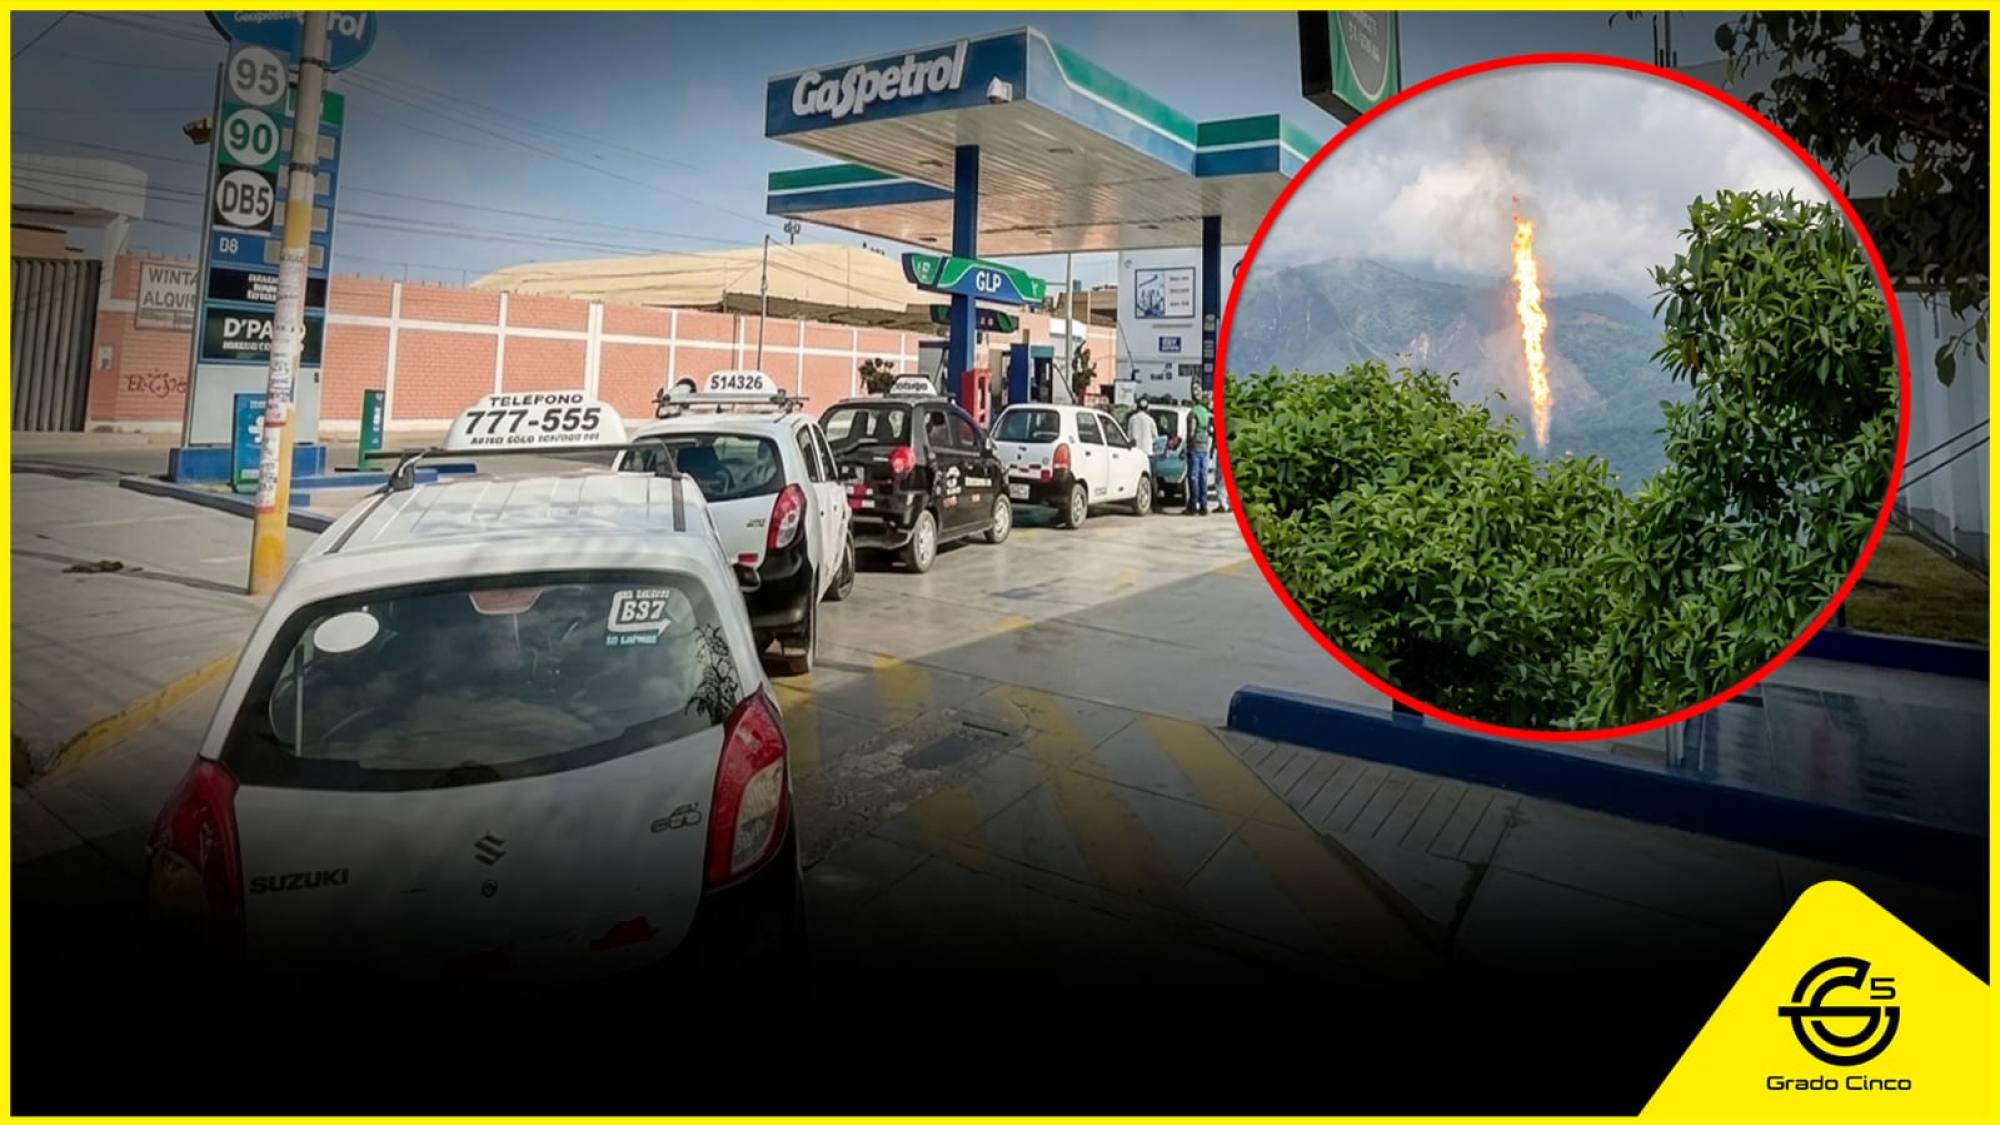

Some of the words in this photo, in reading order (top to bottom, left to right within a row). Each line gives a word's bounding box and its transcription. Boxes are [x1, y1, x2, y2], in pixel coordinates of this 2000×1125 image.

[236, 58, 279, 95] 95
[792, 40, 968, 119] Gaspetrol
[229, 118, 272, 155] 90
[221, 180, 269, 217] DB5
[976, 270, 1002, 293] GLP
[465, 408, 601, 435] 777-555
[249, 867, 349, 894] SUZUKI
